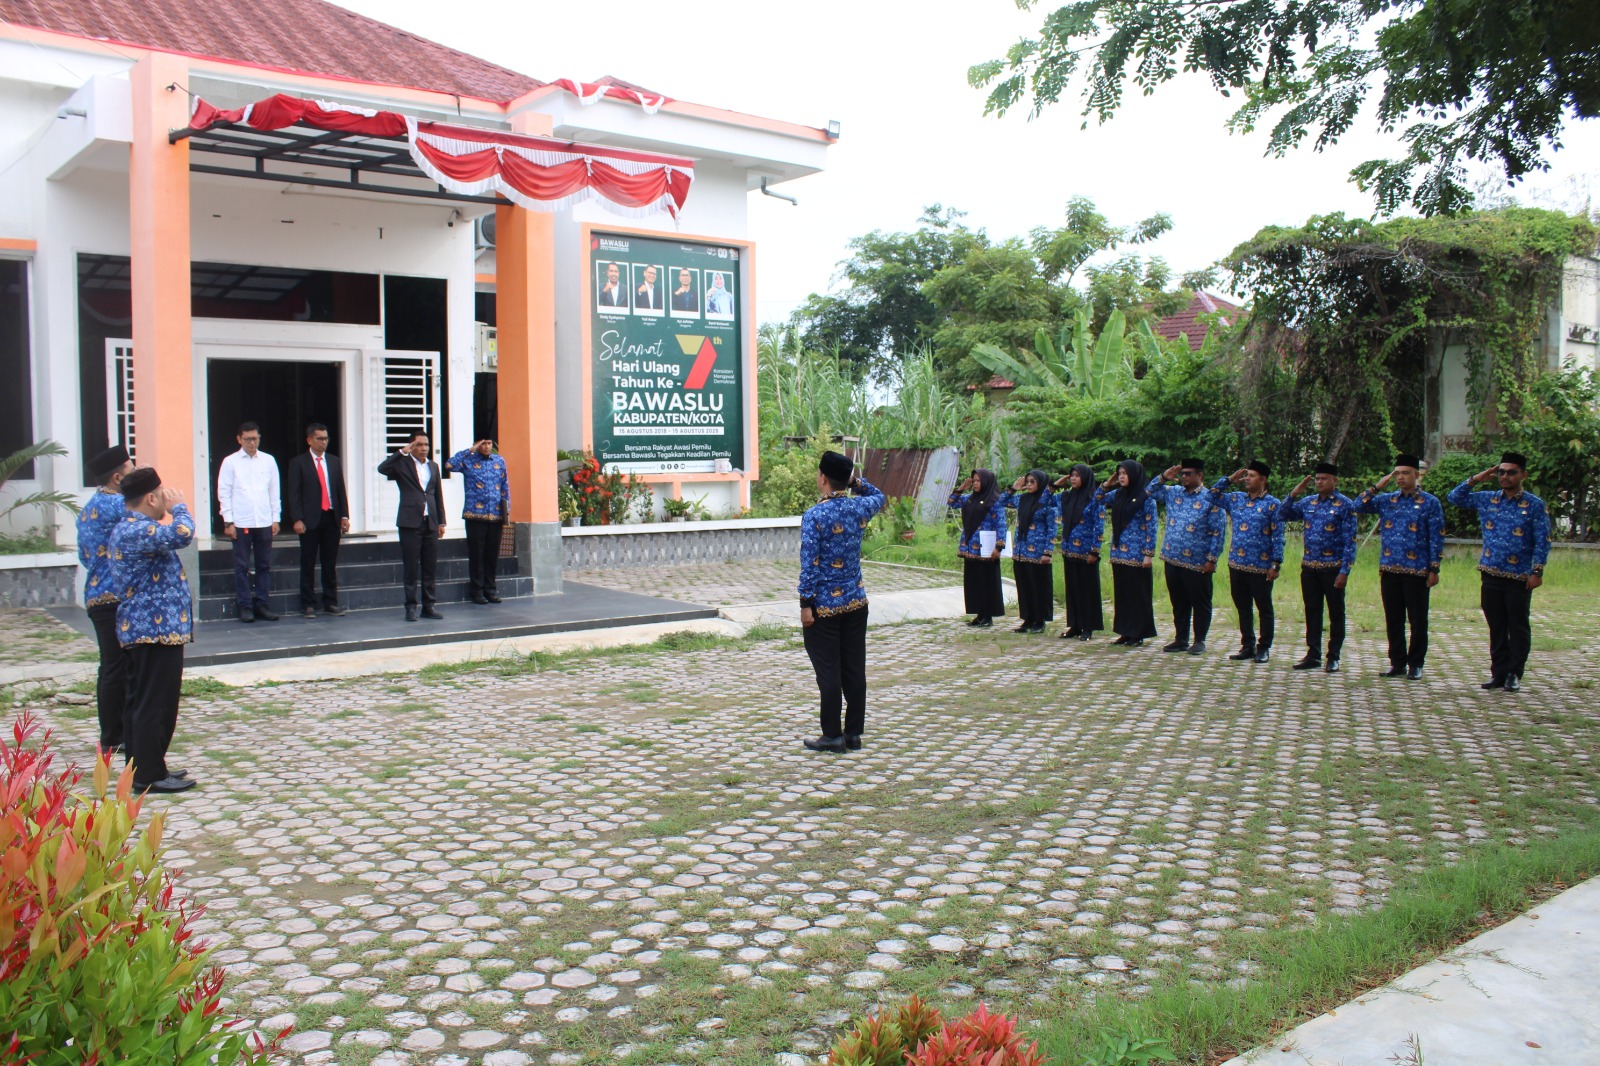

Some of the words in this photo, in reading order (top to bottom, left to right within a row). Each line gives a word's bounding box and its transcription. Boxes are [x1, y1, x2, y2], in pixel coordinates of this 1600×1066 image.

[600, 239, 629, 248] BAWASLU
[600, 330, 664, 361] Selamat
[612, 360, 639, 373] Hari
[643, 361, 680, 377] Ulang
[612, 376, 653, 388] Tahun
[657, 377, 673, 389] Ke
[612, 391, 723, 412] BAWASLU
[613, 412, 724, 425] KABUPATEN/KOTA
